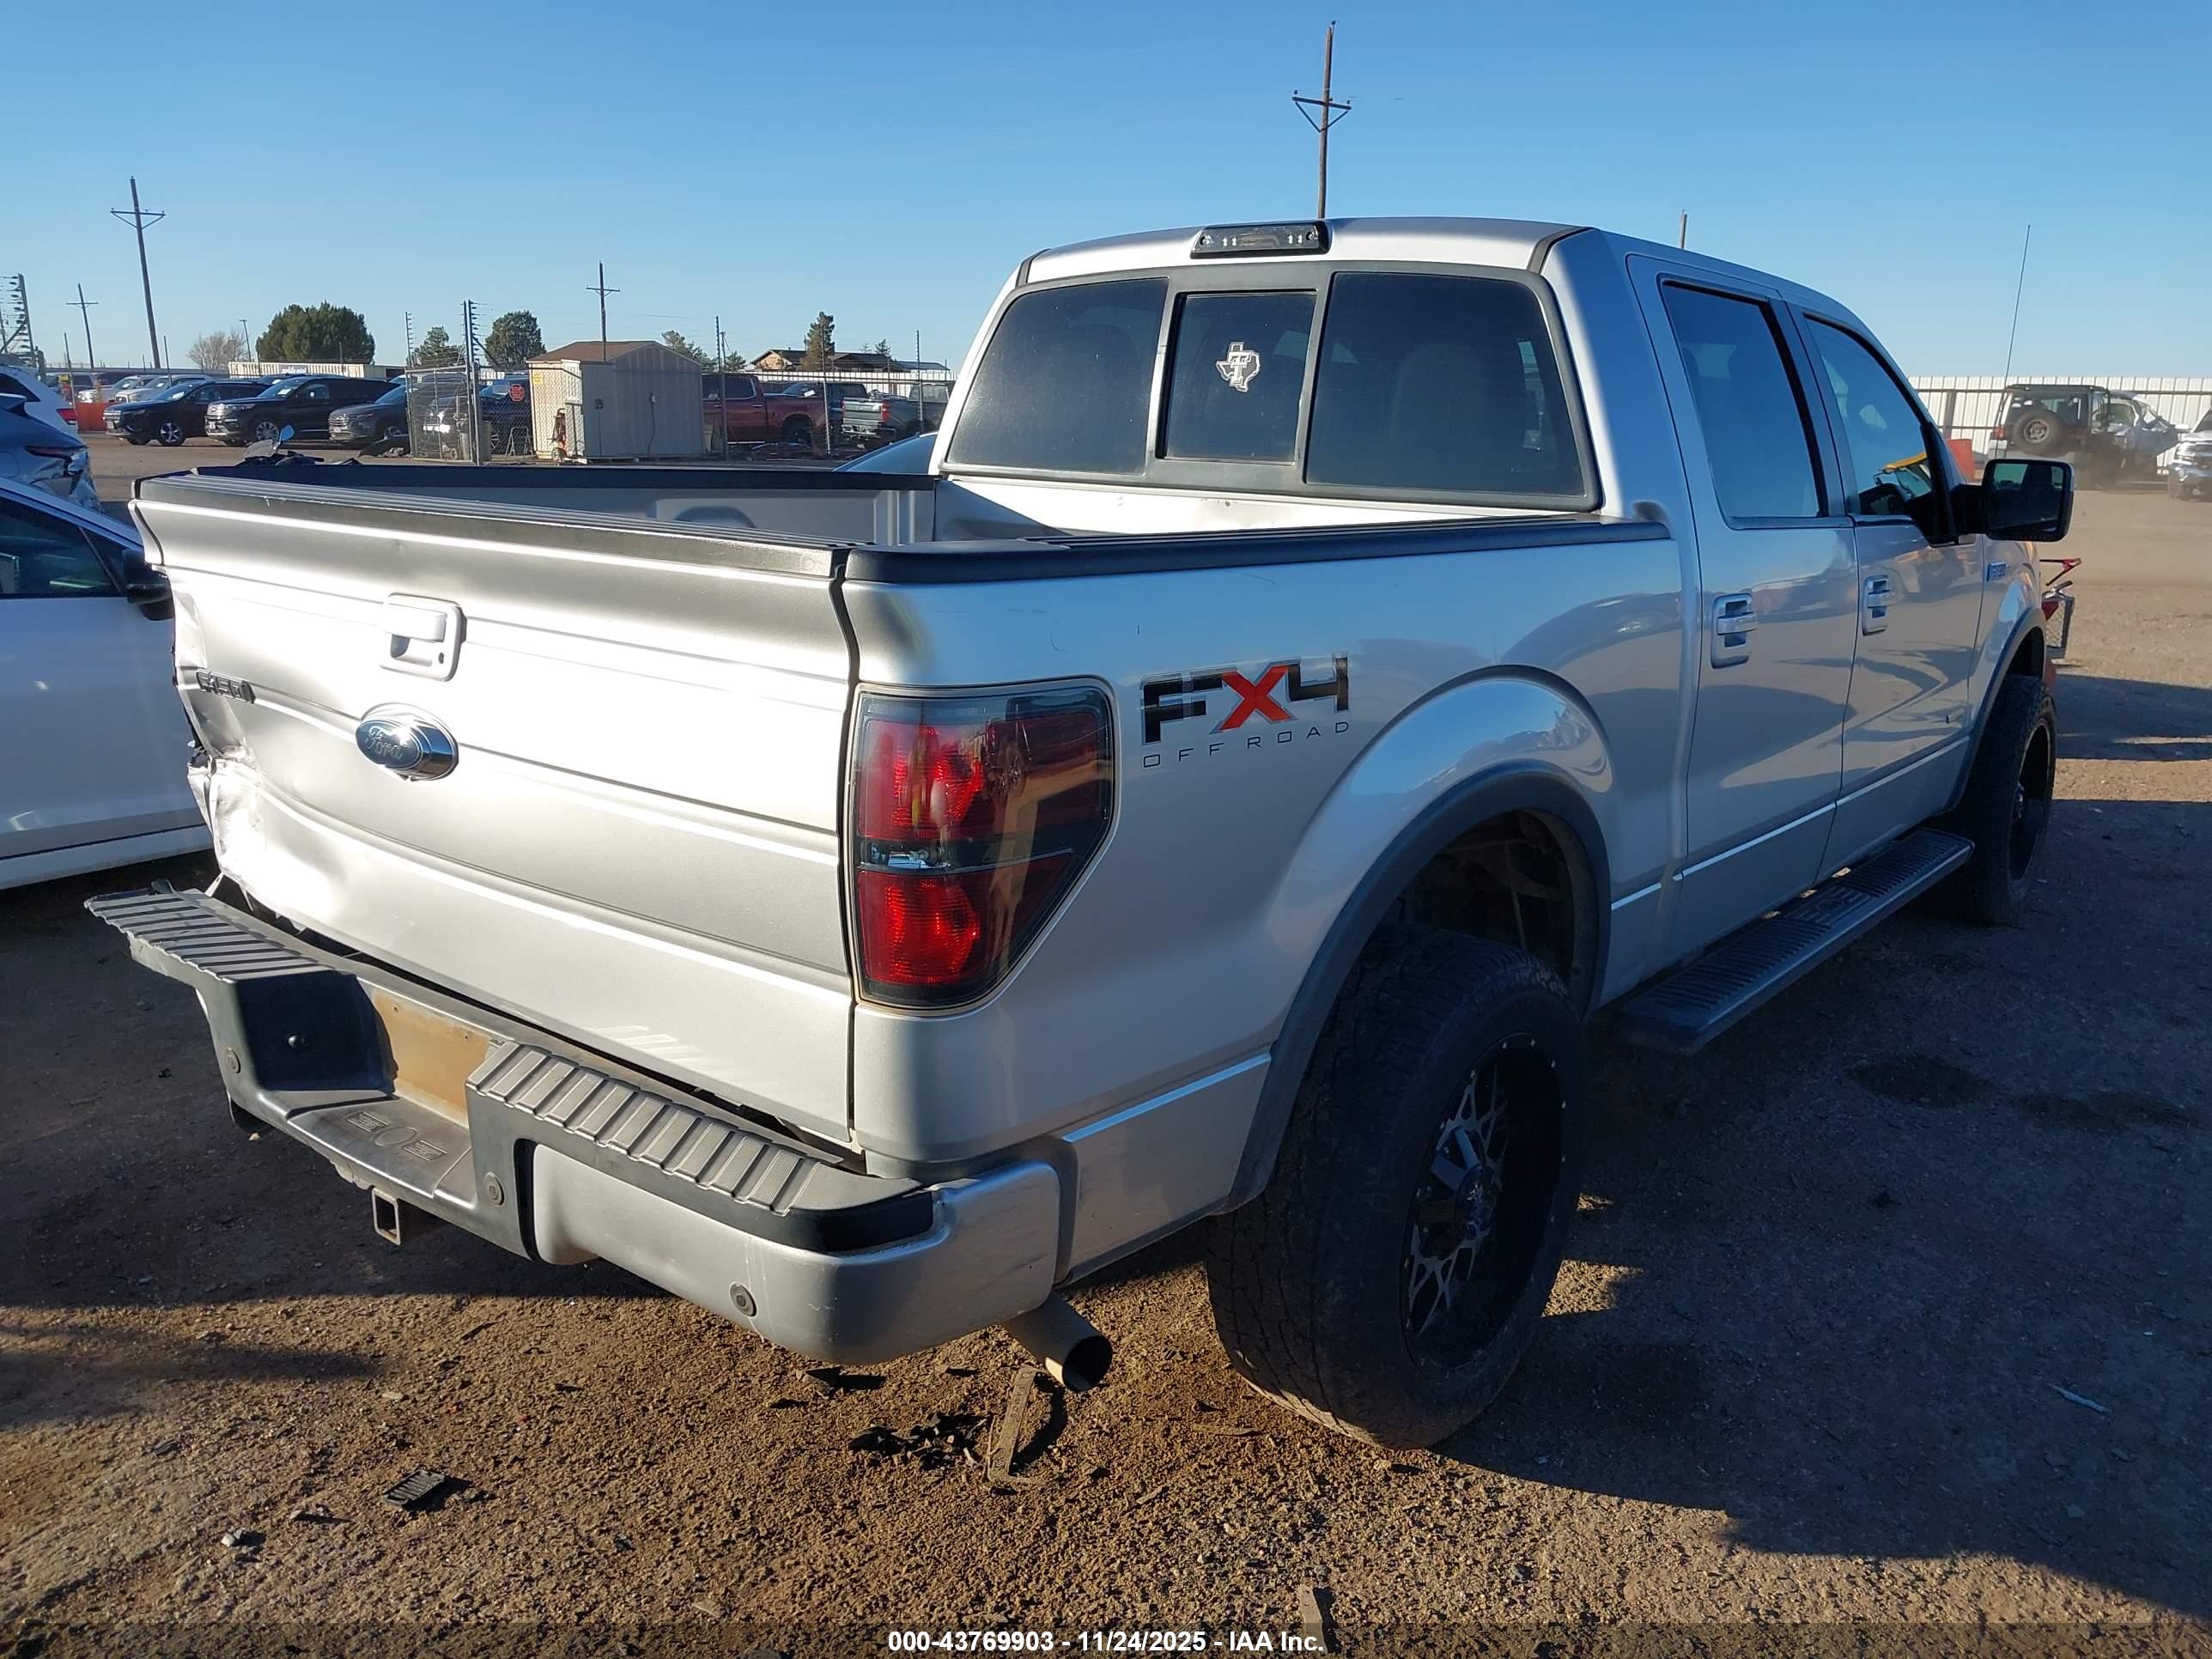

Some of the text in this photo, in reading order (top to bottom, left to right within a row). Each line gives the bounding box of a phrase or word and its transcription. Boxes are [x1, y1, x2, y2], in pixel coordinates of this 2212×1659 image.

[1140, 653, 1349, 745] FX4
[1142, 721, 1350, 769] OFF ROAD
